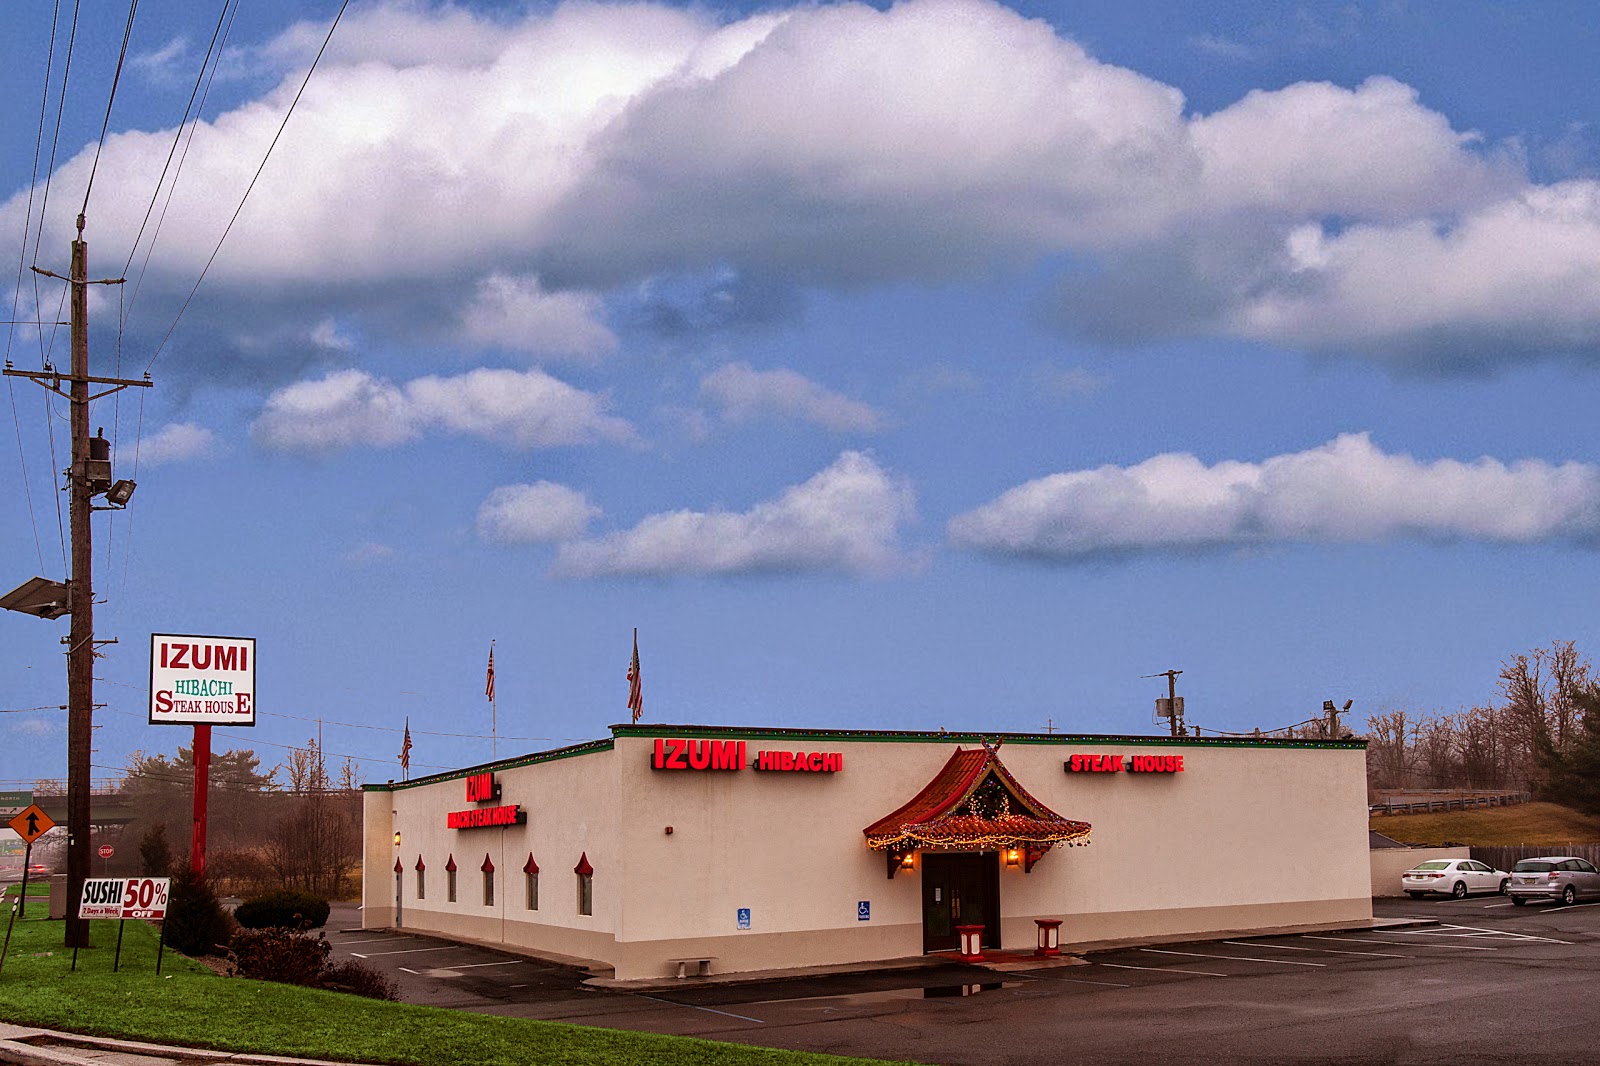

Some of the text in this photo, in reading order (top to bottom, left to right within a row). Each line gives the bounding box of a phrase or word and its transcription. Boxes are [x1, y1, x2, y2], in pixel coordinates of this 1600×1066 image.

[160, 643, 248, 671] IZUMI
[175, 679, 233, 696] HIBACHI
[155, 690, 251, 714] STEAK HOUSE
[653, 738, 842, 772] IZUMI HIBACHI
[1070, 754, 1185, 772] STEAK HOUSE
[466, 772, 493, 802] IZUMI
[447, 811, 471, 828] ACHI
[492, 805, 517, 824] HOUSE
[100, 847, 113, 855] STOP
[83, 879, 167, 908] SUSHI 50%
